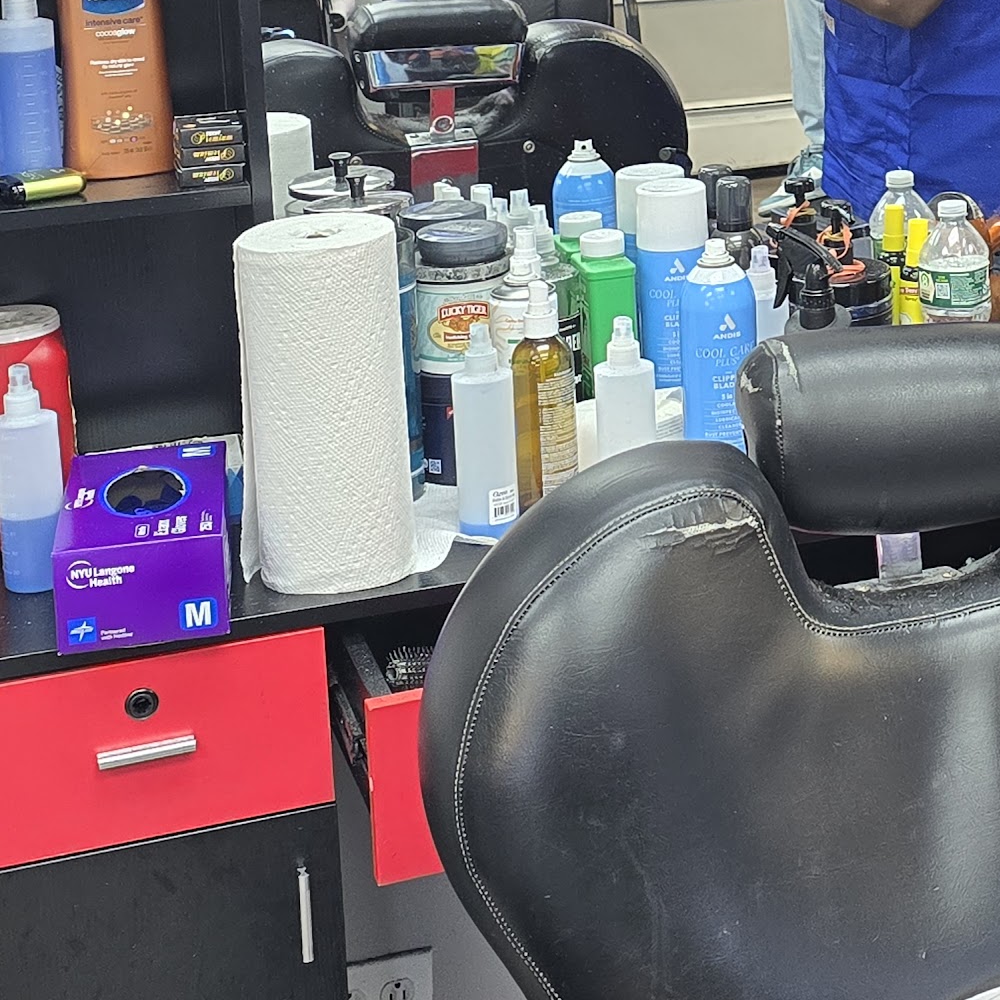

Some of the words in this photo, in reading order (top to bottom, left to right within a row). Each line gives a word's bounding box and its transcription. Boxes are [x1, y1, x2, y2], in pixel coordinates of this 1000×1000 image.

[85, 18, 122, 27] intensive
[122, 16, 140, 25] care
[649, 288, 676, 299] COOL
[441, 305, 466, 319] LUCKY
[467, 304, 487, 315] TIGER
[712, 331, 742, 340] ANDIS
[695, 348, 726, 359] COOL
[715, 356, 740, 367] PLUS
[712, 374, 735, 382] CLIPP
[713, 382, 735, 390] BLAD
[71, 568, 93, 580] NYU
[93, 565, 135, 577] Langone
[89, 576, 123, 588] Health
[184, 600, 212, 629] M
